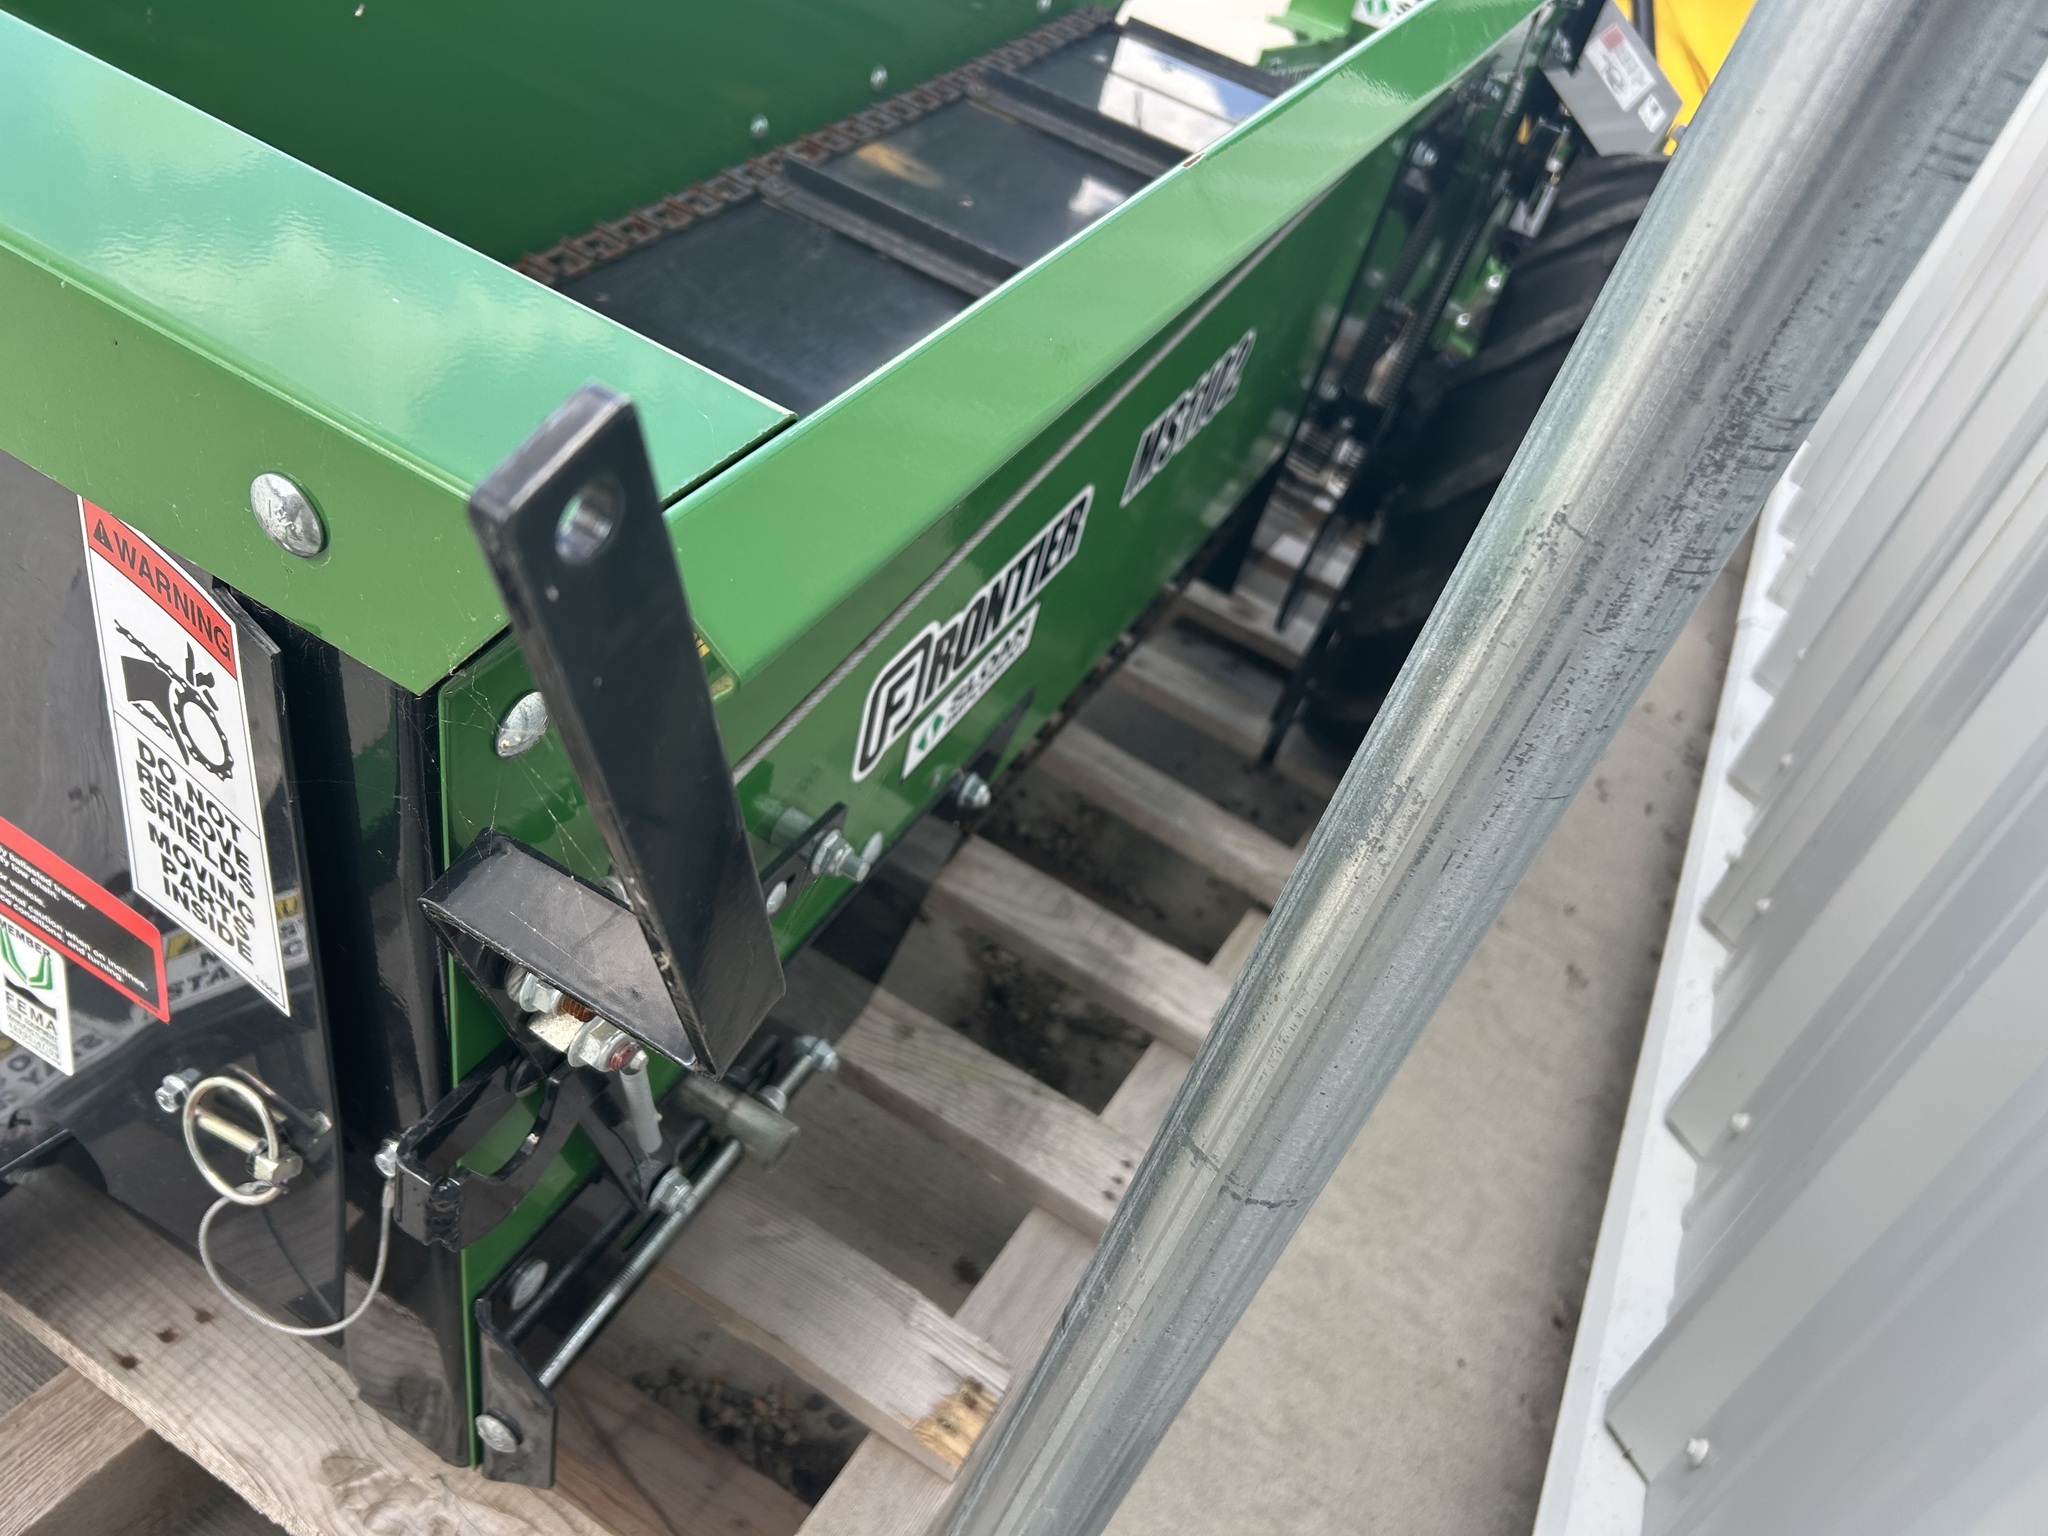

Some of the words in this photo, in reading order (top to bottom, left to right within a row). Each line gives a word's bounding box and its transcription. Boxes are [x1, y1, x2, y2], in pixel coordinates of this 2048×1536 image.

[114, 531, 231, 661] WARNING
[858, 495, 1088, 773] FRONTIER
[136, 759, 251, 877] REMOVE
[137, 737, 176, 785] DO
[186, 779, 241, 844] NOT
[11, 862, 29, 880] tow
[140, 787, 256, 899] SHIELDS
[148, 820, 256, 928] MOVING
[0, 917, 51, 959] MEMBER
[28, 904, 64, 933] caution
[65, 930, 91, 952] when
[92, 949, 106, 962] on
[53, 883, 87, 910] tractor
[161, 852, 250, 941] PARTS
[163, 875, 254, 966] INSIDE
[67, 940, 86, 956] and
[5, 989, 58, 1036] FEMA
